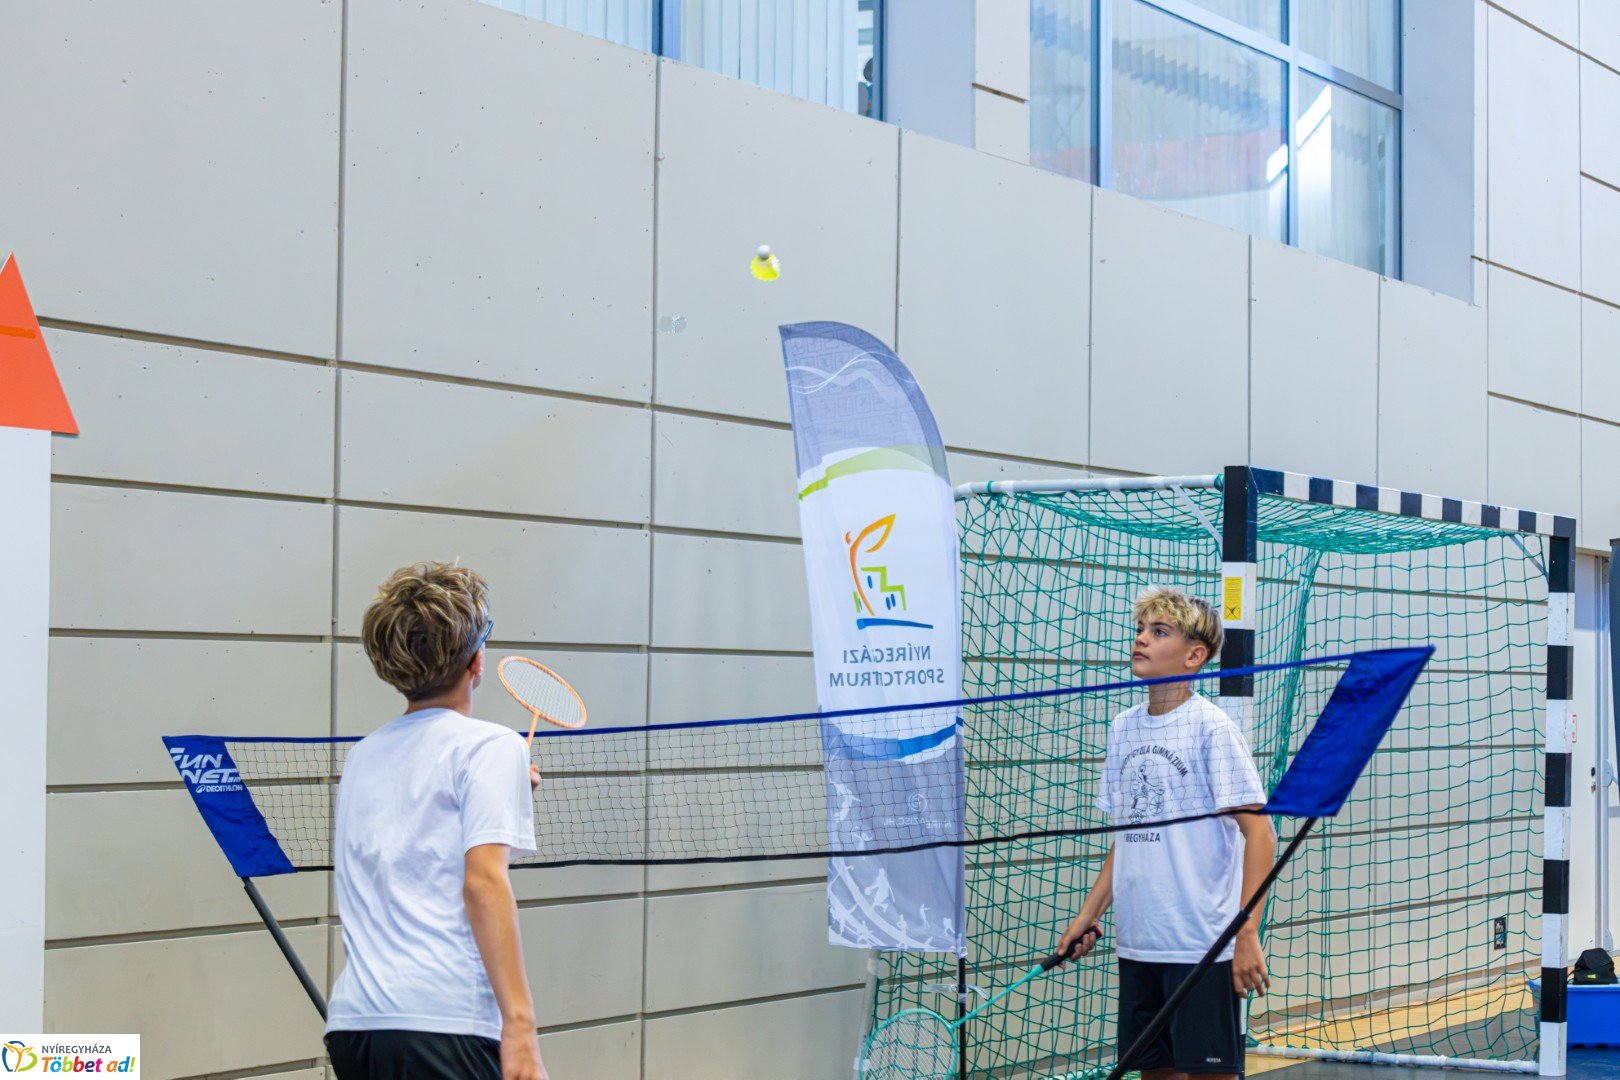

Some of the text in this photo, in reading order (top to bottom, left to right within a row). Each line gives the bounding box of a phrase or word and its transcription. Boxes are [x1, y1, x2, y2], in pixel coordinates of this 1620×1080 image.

[1152, 745, 1189, 777] GIMNÁZIUM
[181, 768, 238, 784] NET
[206, 784, 243, 793] DECATHLON
